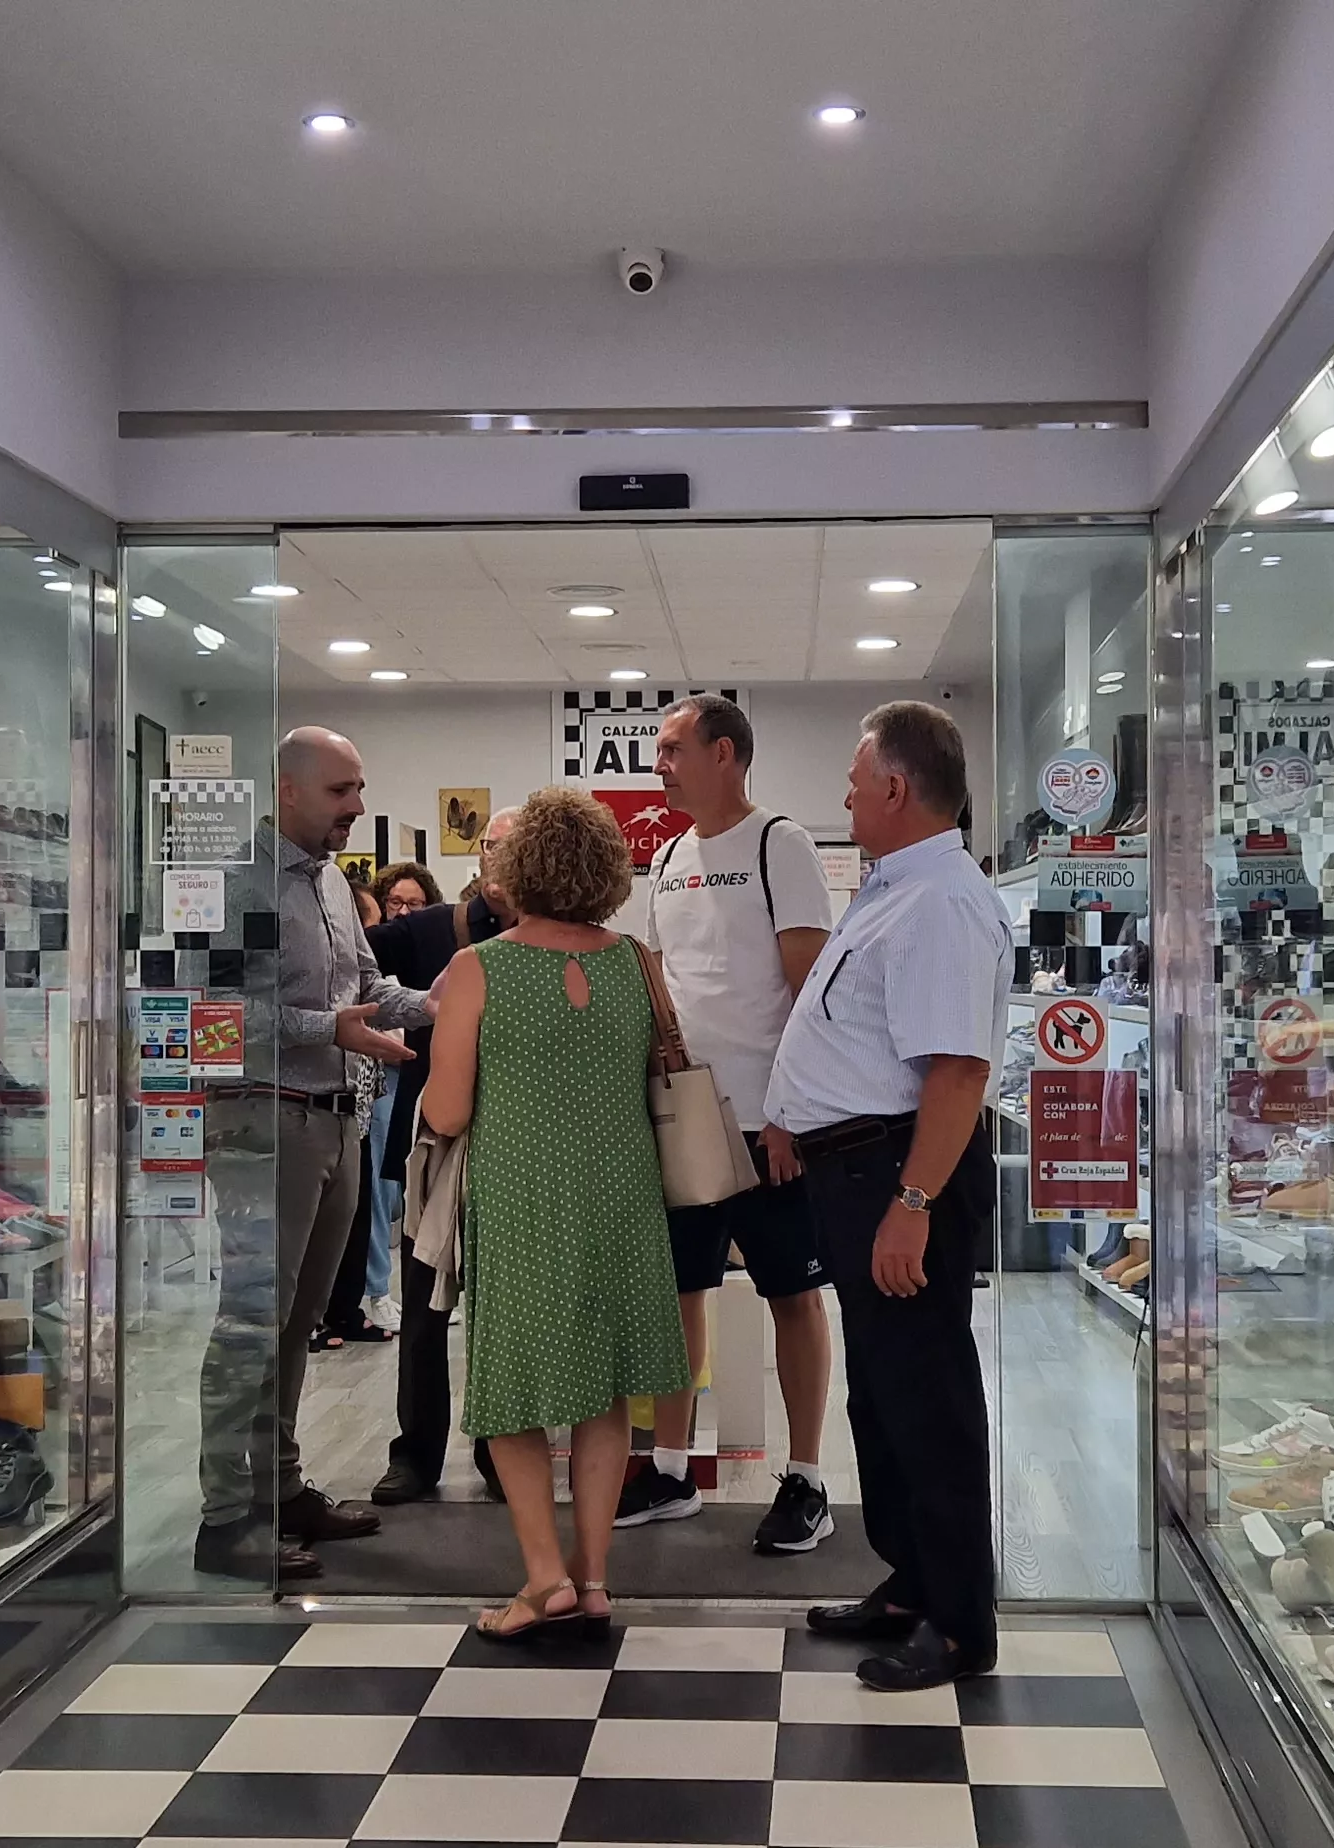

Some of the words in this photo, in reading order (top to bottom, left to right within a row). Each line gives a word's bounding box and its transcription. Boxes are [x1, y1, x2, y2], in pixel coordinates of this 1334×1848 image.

[602, 726, 659, 737] CALZAD
[593, 740, 654, 775] AL
[178, 812, 224, 822] HORARIO
[1057, 860, 1128, 871] establecimiento
[658, 876, 688, 894] JACK
[701, 872, 749, 888] JONES
[1050, 871, 1135, 888] ADHERIDO
[178, 881, 209, 889] SEGURO
[1043, 1085, 1068, 1094] ESTE
[1043, 1102, 1099, 1111] COLABORA
[1043, 1111, 1067, 1120] CON
[1048, 1132, 1069, 1142] plan
[1070, 1132, 1081, 1141] de
[1061, 1166, 1077, 1174] Cruz
[1078, 1166, 1094, 1176] Roja
[1095, 1166, 1125, 1177] Española
